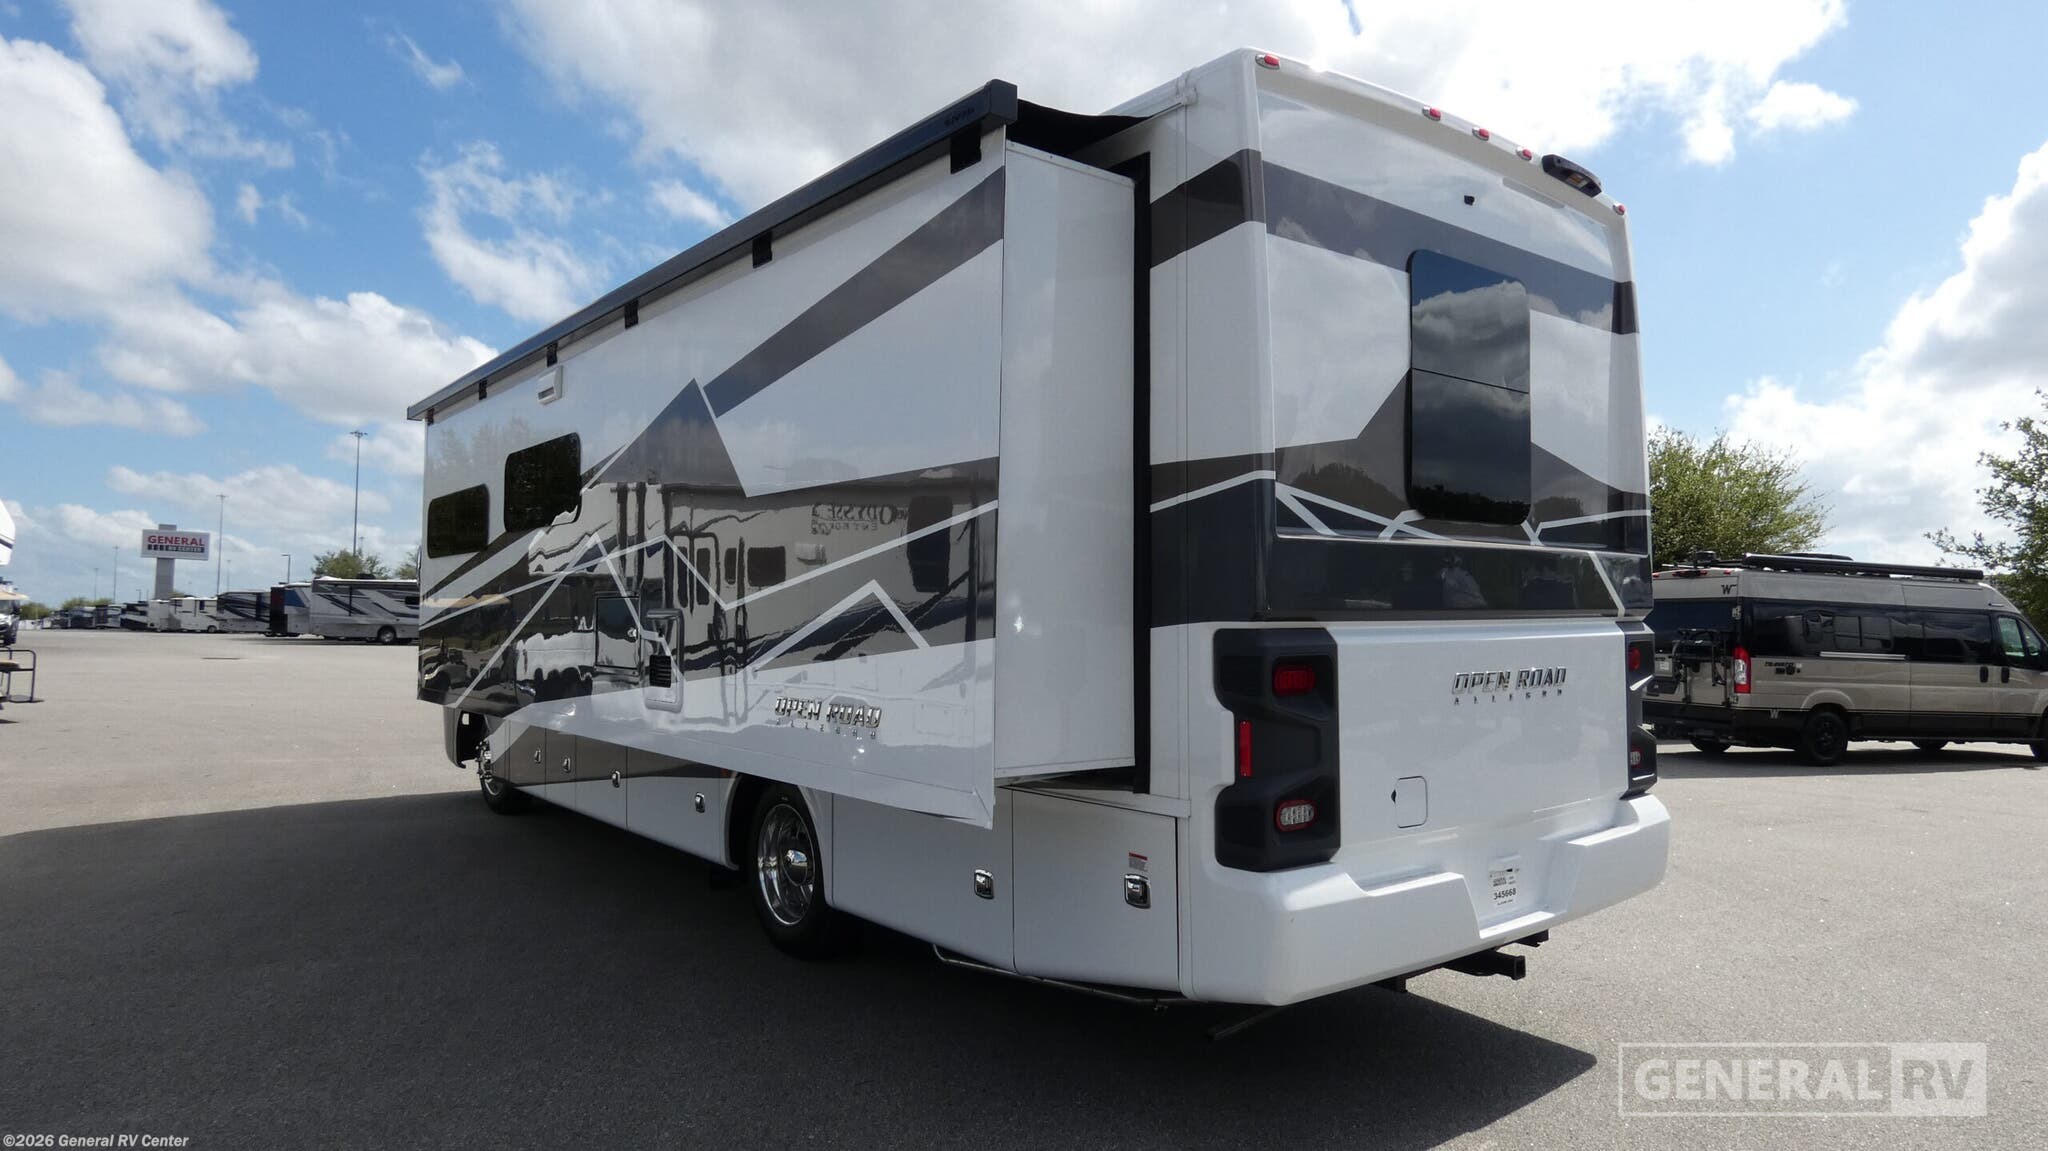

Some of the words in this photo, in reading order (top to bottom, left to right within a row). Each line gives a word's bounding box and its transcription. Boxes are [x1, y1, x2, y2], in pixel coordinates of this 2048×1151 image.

[147, 535, 206, 546] GENERAL
[1452, 671, 1511, 694] OPEN
[1516, 666, 1567, 690] ROAD
[775, 697, 822, 721] OPEN
[826, 703, 881, 729] ROAD
[1493, 887, 1517, 900] 345668
